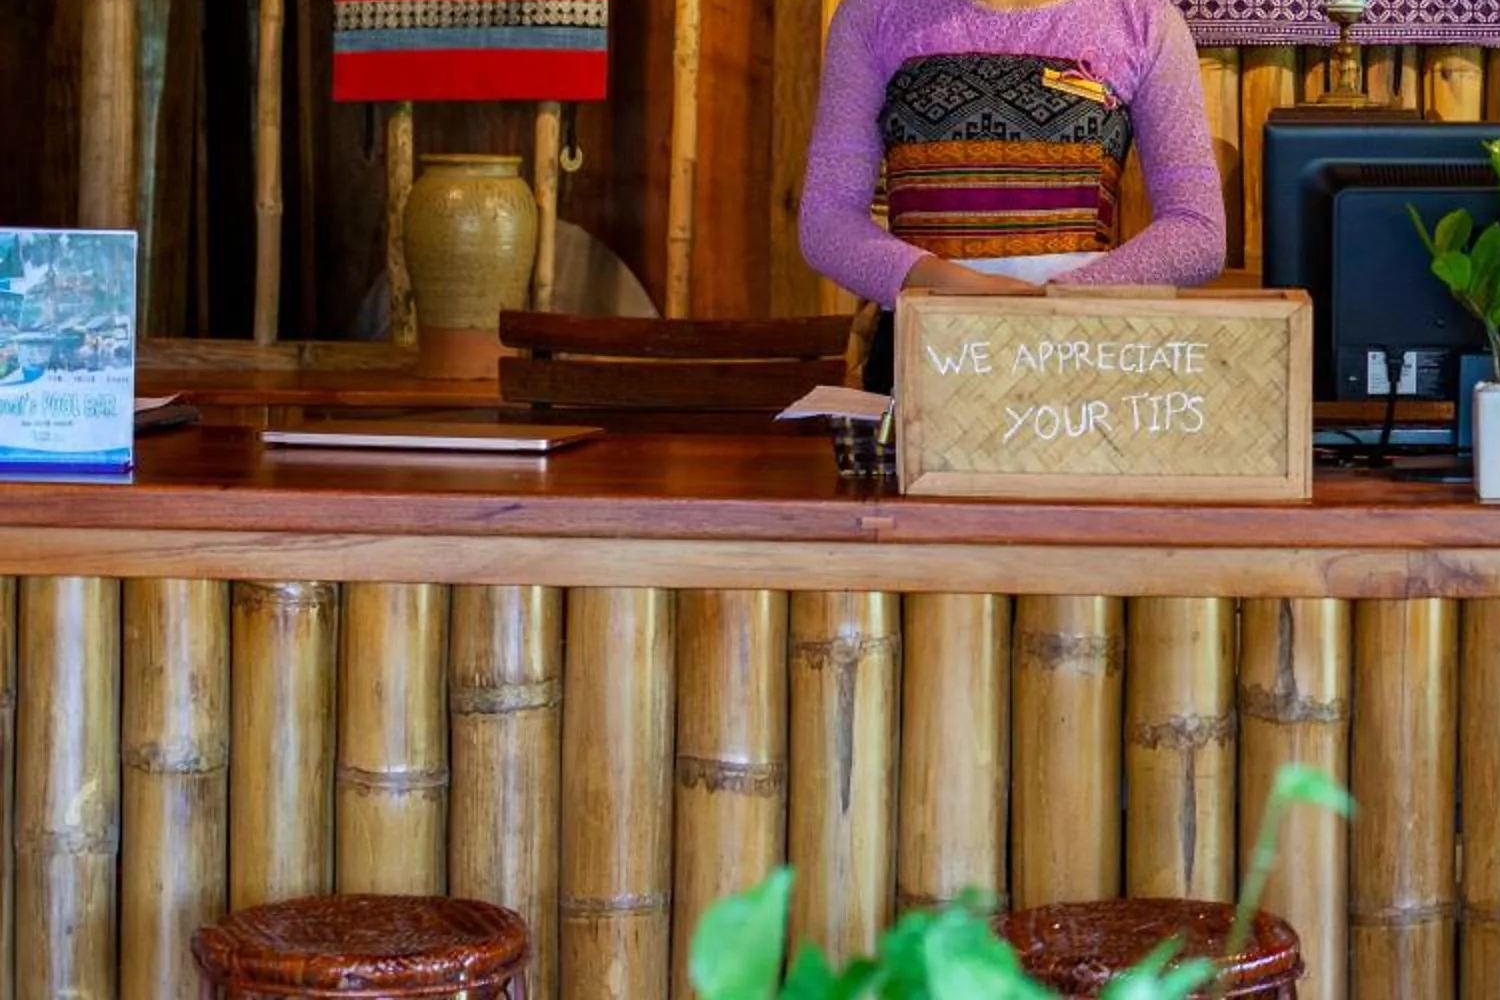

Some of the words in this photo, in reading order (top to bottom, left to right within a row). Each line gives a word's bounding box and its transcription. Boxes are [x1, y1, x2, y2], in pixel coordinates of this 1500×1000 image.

[927, 341, 992, 375] WE
[1011, 340, 1209, 374] APPRECIATE
[1002, 401, 1112, 443] YOUR
[1121, 391, 1204, 435] TIPS
